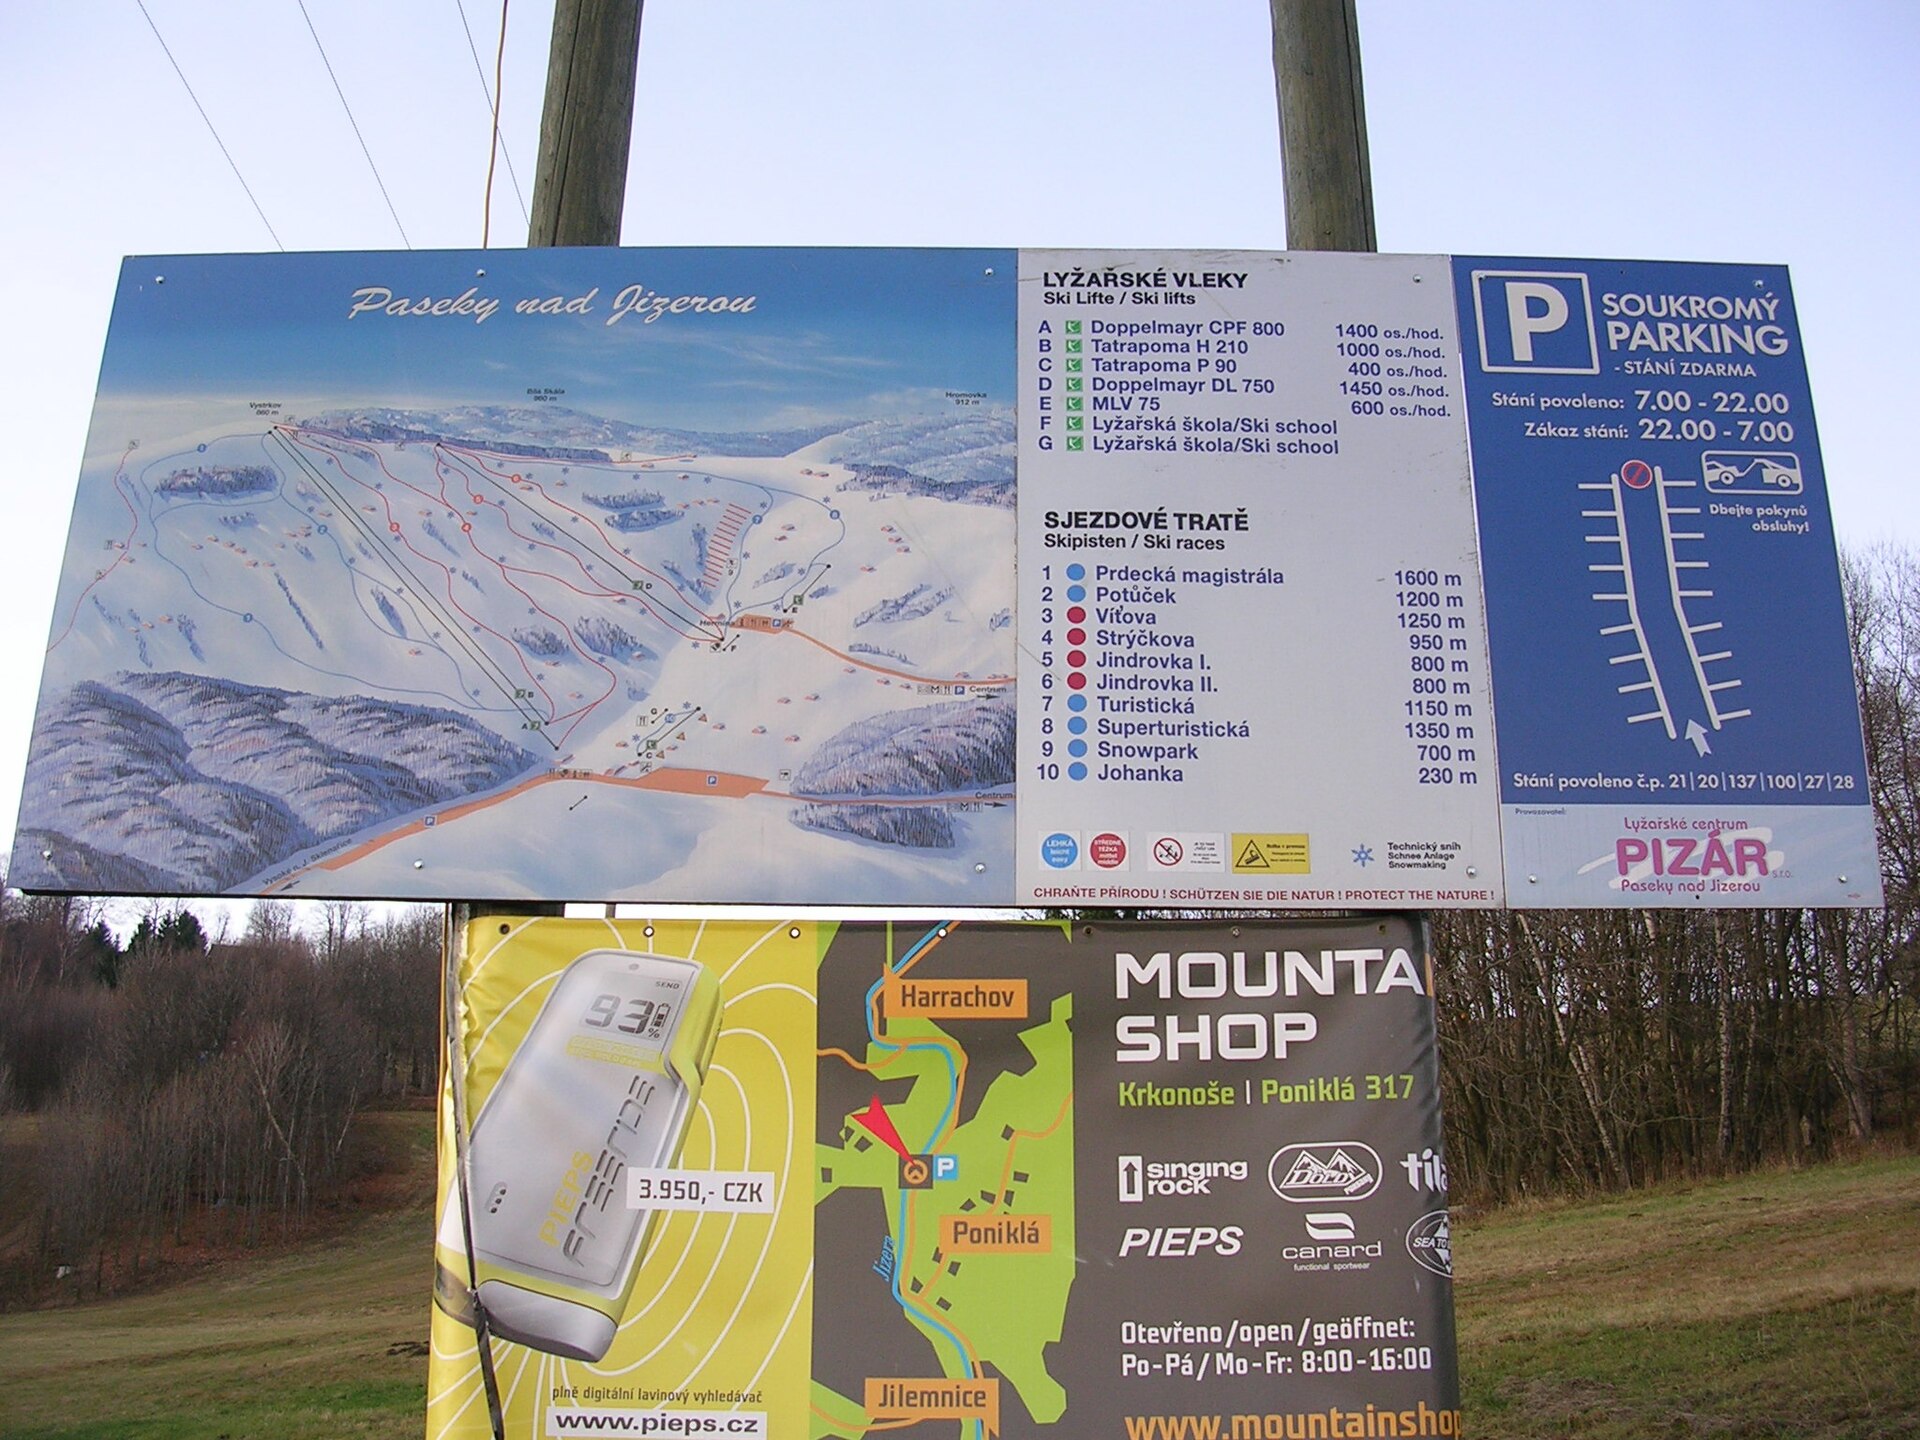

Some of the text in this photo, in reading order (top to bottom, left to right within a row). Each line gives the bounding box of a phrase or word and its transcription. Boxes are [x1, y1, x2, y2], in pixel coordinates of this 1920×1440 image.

[1043, 267, 1248, 289] LYŽAŘSKÉ VLEKY
[348, 284, 757, 327] Paseky nad Jizerou
[1043, 291, 1196, 306] Ski Lifte Ski lifts
[1601, 292, 1780, 321] SOUKROMÝ
[1091, 320, 1285, 339] Doppelmayr CPF 800
[1505, 281, 1569, 362] P
[1336, 324, 1445, 340] 1400 os./hod.
[1607, 321, 1789, 356] PARKING
[1091, 339, 1249, 358] Tatrapoma H 210
[1336, 343, 1446, 359] 1000 os./hod.
[1092, 359, 1237, 377] Tatrapoma P 90
[1348, 362, 1448, 379] 400 os./hod.
[1624, 359, 1757, 378] STÁNÍ ZDARMA
[945, 391, 987, 399] Hromovka
[1092, 378, 1275, 397] Doppelmayr DL 750
[1339, 381, 1449, 398] 1450 os./hod.
[1092, 396, 1161, 412] MLV 75
[1351, 401, 1451, 418] 600 os./hod.
[1492, 390, 1789, 415] Stání povoleno: 7.00 22.00
[1092, 416, 1337, 435] Lyžařská škola/Ski school
[1524, 418, 1794, 443] Zákaz stání: 22.00 7.00
[1043, 506, 1249, 531] SJEZDOVÉ TRATĚ
[1709, 503, 1808, 519] Dbejte pokynů
[1752, 520, 1810, 535] obsluhy!
[1044, 533, 1225, 551] Skipisten Ski races
[1095, 565, 1284, 587] Prdecká magistrála
[1394, 570, 1462, 587] 1600 m
[1095, 586, 1176, 605] Potůček
[1395, 592, 1463, 608] 1200 m
[1095, 606, 1157, 625] Víťova
[1397, 613, 1465, 630] 1250 m
[1095, 629, 1195, 650] Strýčkova
[1096, 652, 1211, 671] Jindrovka I.
[969, 685, 1007, 694] Centrum
[1097, 674, 1218, 693] Jindrovka II.
[1097, 696, 1195, 715] Turistická
[1404, 700, 1472, 717] 1150 m
[1097, 718, 1250, 739] Superturistická
[1404, 723, 1474, 739] 1350 m
[1097, 742, 1199, 761] Snowpark
[1097, 765, 1183, 783] Johanka
[1513, 772, 1554, 788] Stání
[1558, 772, 1633, 794] povoleno
[1636, 773, 1665, 792] č.p.
[975, 791, 1014, 799] Centrum
[1624, 816, 1748, 832] Lyžařské centrum
[1387, 841, 1462, 852] Technický sníh
[1616, 829, 1769, 877] PIZÁR
[1388, 852, 1455, 861] Schnee Anlage
[1388, 860, 1446, 870] Snowmaking
[1034, 883, 1490, 901] CHRAŇTE PŘÍRODU SCHÜTZEN SIE DIE NATUR PROTECT THE NATURE
[1621, 878, 1760, 895] Paseky nad Jizerou
[655, 981, 680, 990] SEND
[901, 985, 1015, 1009] Harrachov
[585, 993, 655, 1034] 93
[1115, 1012, 1317, 1063] SHOP
[1119, 1074, 1414, 1108] Krkonoše Poniklá 317
[1146, 1161, 1248, 1181] singing
[724, 1182, 764, 1204] CZK
[1147, 1179, 1211, 1195] rock
[953, 1219, 1039, 1245] Poniklá
[1118, 1226, 1244, 1257] PIEPS
[1282, 1240, 1382, 1260] canard
[1293, 1262, 1371, 1272] functional sportwear
[552, 1385, 763, 1405] plně digitální lavinový vyhledávač
[878, 1383, 987, 1409] Jilemnice
[556, 1413, 758, 1436] www.pieps.cz
